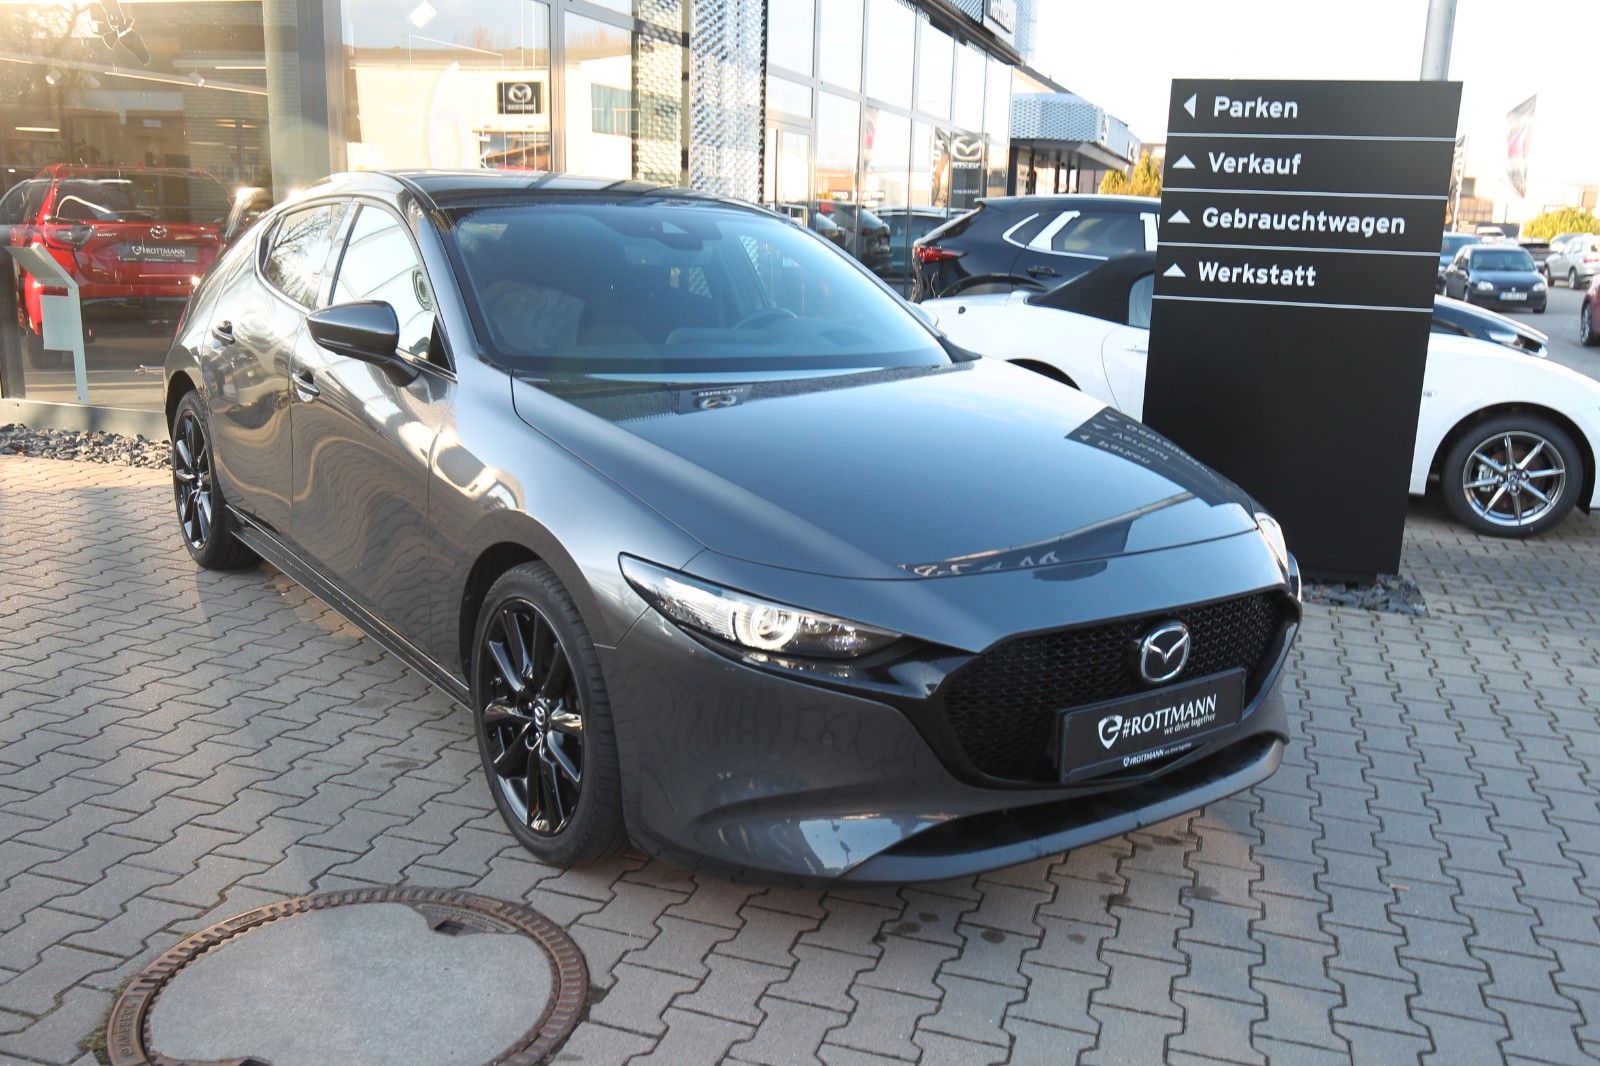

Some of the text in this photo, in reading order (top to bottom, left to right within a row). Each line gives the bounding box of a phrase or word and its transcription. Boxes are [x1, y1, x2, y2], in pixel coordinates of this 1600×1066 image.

[1213, 95, 1298, 119] Parken
[1207, 151, 1302, 175] Verkauf
[1202, 206, 1405, 238] Gebrauchtwagen
[1198, 261, 1316, 287] Werkstatt
[1122, 693, 1217, 739] #ROTTMANN
[1163, 712, 1216, 736] we drive together
